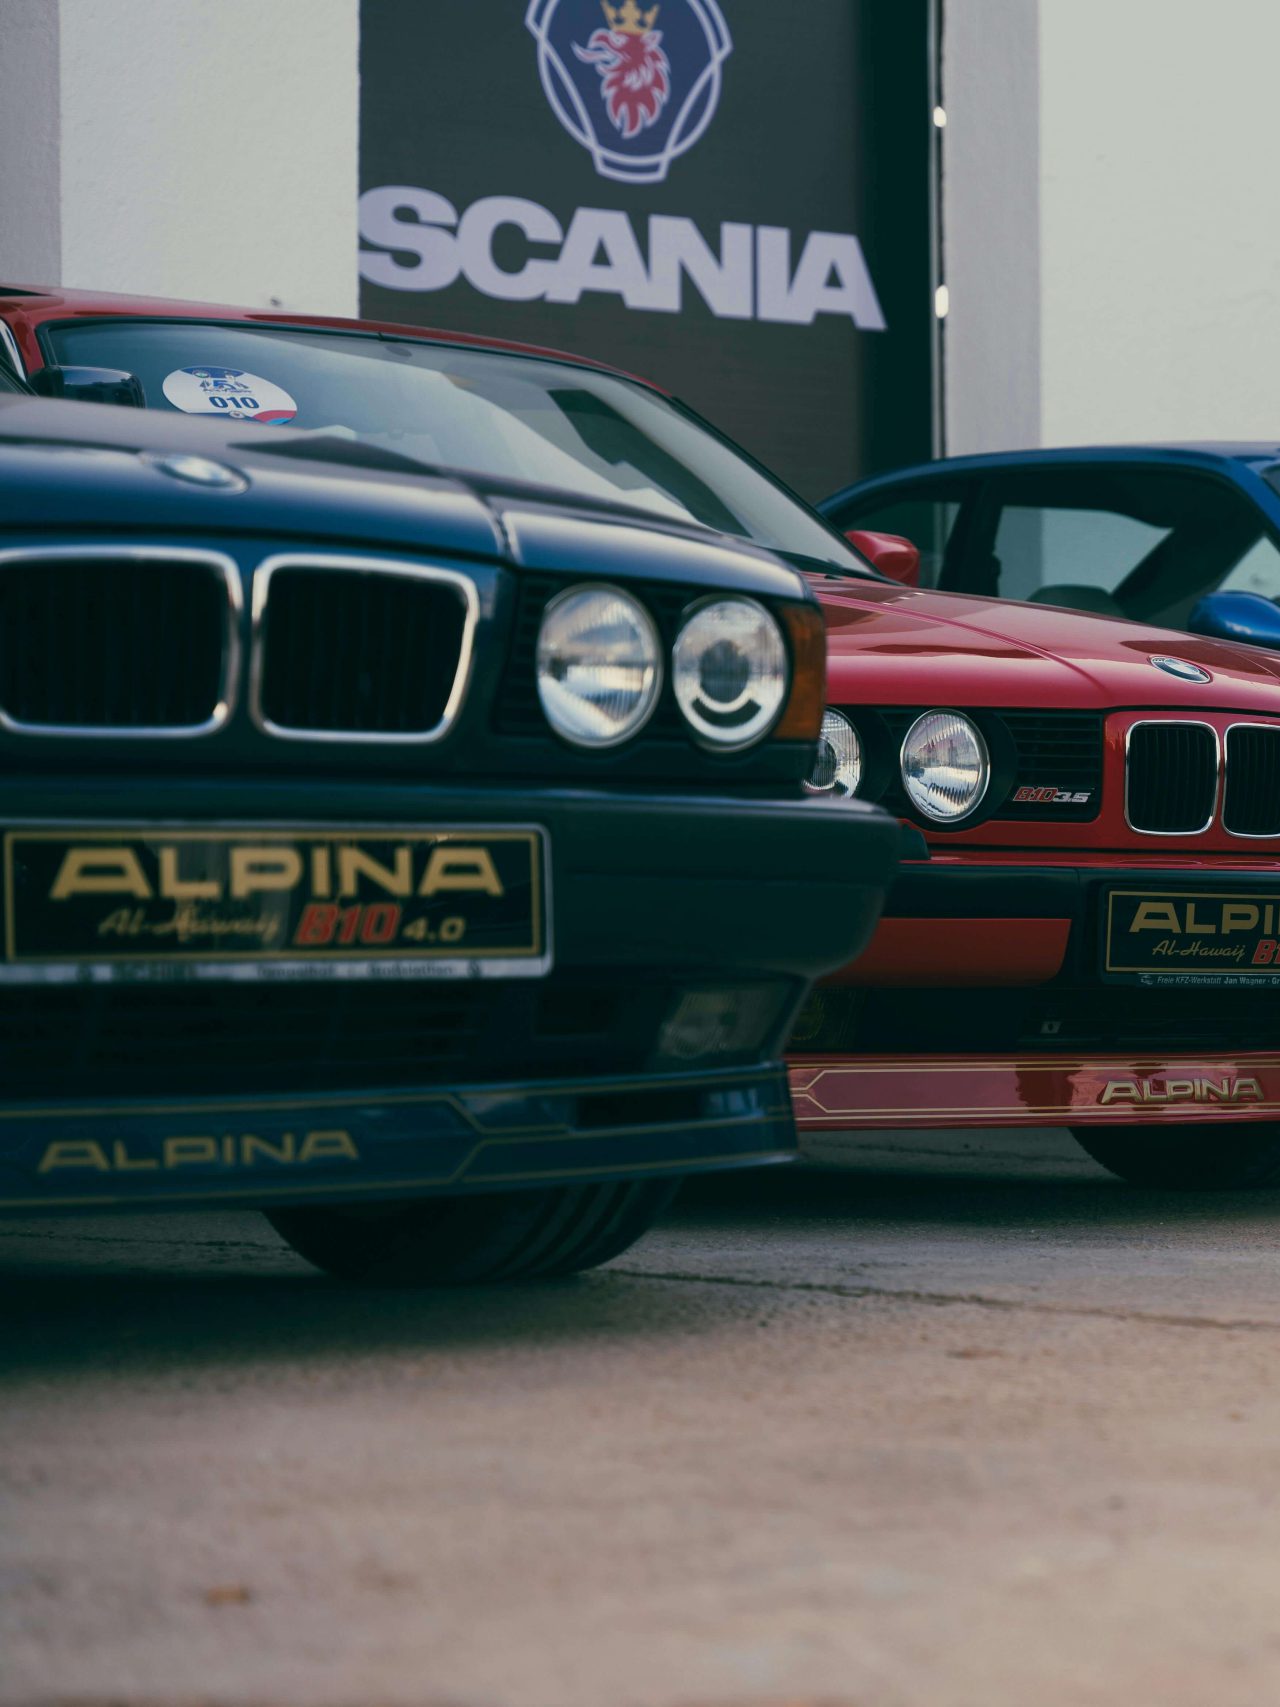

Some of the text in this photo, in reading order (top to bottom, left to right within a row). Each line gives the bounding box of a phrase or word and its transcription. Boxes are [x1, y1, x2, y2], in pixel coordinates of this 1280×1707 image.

[359, 185, 888, 331] SCANIA
[209, 396, 260, 409] 010
[1012, 785, 1059, 803] B10
[50, 847, 504, 899] ALPINA
[294, 903, 402, 945] B10
[403, 915, 466, 942] 4.0
[1151, 939, 1247, 963] Al-Hawaij
[1156, 976, 1174, 985] Freie
[1175, 976, 1222, 985] KFZ-Werkstatt
[1224, 976, 1238, 985] Jan
[1240, 976, 1266, 987] Wagner
[1100, 1077, 1265, 1105] ALPINA
[37, 1130, 359, 1173] ALPINA
